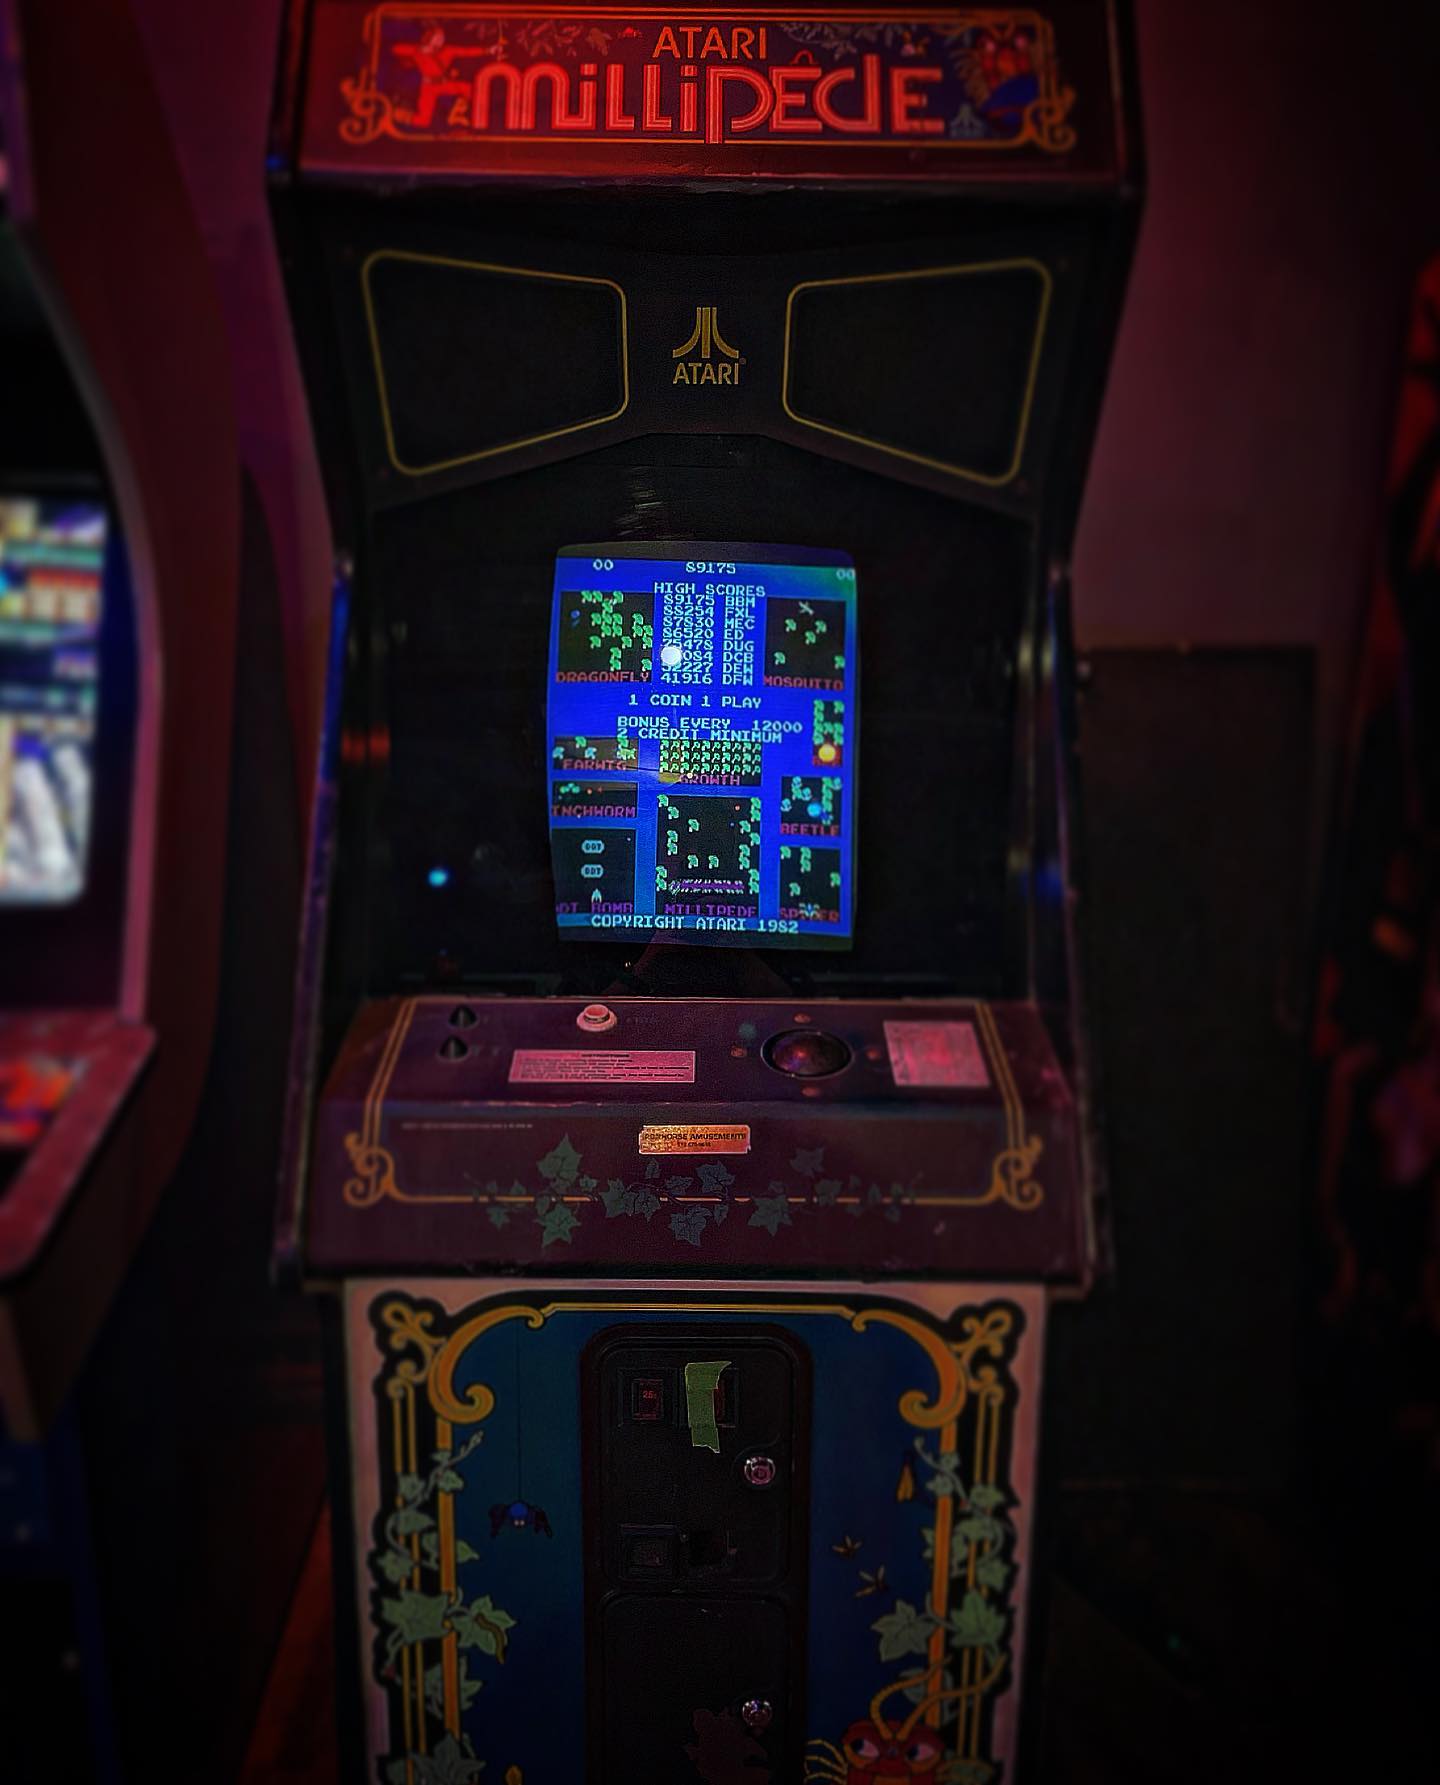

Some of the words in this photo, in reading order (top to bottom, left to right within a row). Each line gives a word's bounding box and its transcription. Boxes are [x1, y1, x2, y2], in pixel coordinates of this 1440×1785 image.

[653, 27, 766, 59] ATARI
[673, 362, 740, 385] ATARI
[686, 562, 736, 574] 89175
[654, 581, 696, 594] HIGH
[705, 583, 766, 597] SCORES
[664, 594, 715, 606] 89175
[663, 605, 714, 618] 88254
[725, 606, 755, 619] FXL
[663, 616, 714, 628] 87830
[724, 618, 755, 630] MEC
[662, 627, 714, 639] 86520
[724, 629, 744, 641] ED
[723, 641, 754, 652] DUG
[723, 652, 753, 664] DCB
[556, 671, 649, 683] DRAGONFLY
[660, 673, 712, 685] 41916
[722, 674, 753, 686] DFW
[763, 676, 844, 691] MOSQUITO
[629, 694, 638, 706] 1
[650, 694, 692, 707] COIN
[701, 696, 711, 707] 1
[721, 696, 762, 709] PLAY
[617, 716, 670, 728] BONUS
[680, 717, 731, 730] EVERY
[751, 720, 803, 733] 12000
[638, 728, 700, 740] CREDIT
[710, 729, 782, 744] MINIMUM
[552, 804, 636, 818] INCHWORM
[663, 903, 757, 917] MILLIPEDE
[591, 914, 685, 929] COPYRIGHT
[696, 916, 746, 931] ATARI
[758, 919, 799, 934] 1982
